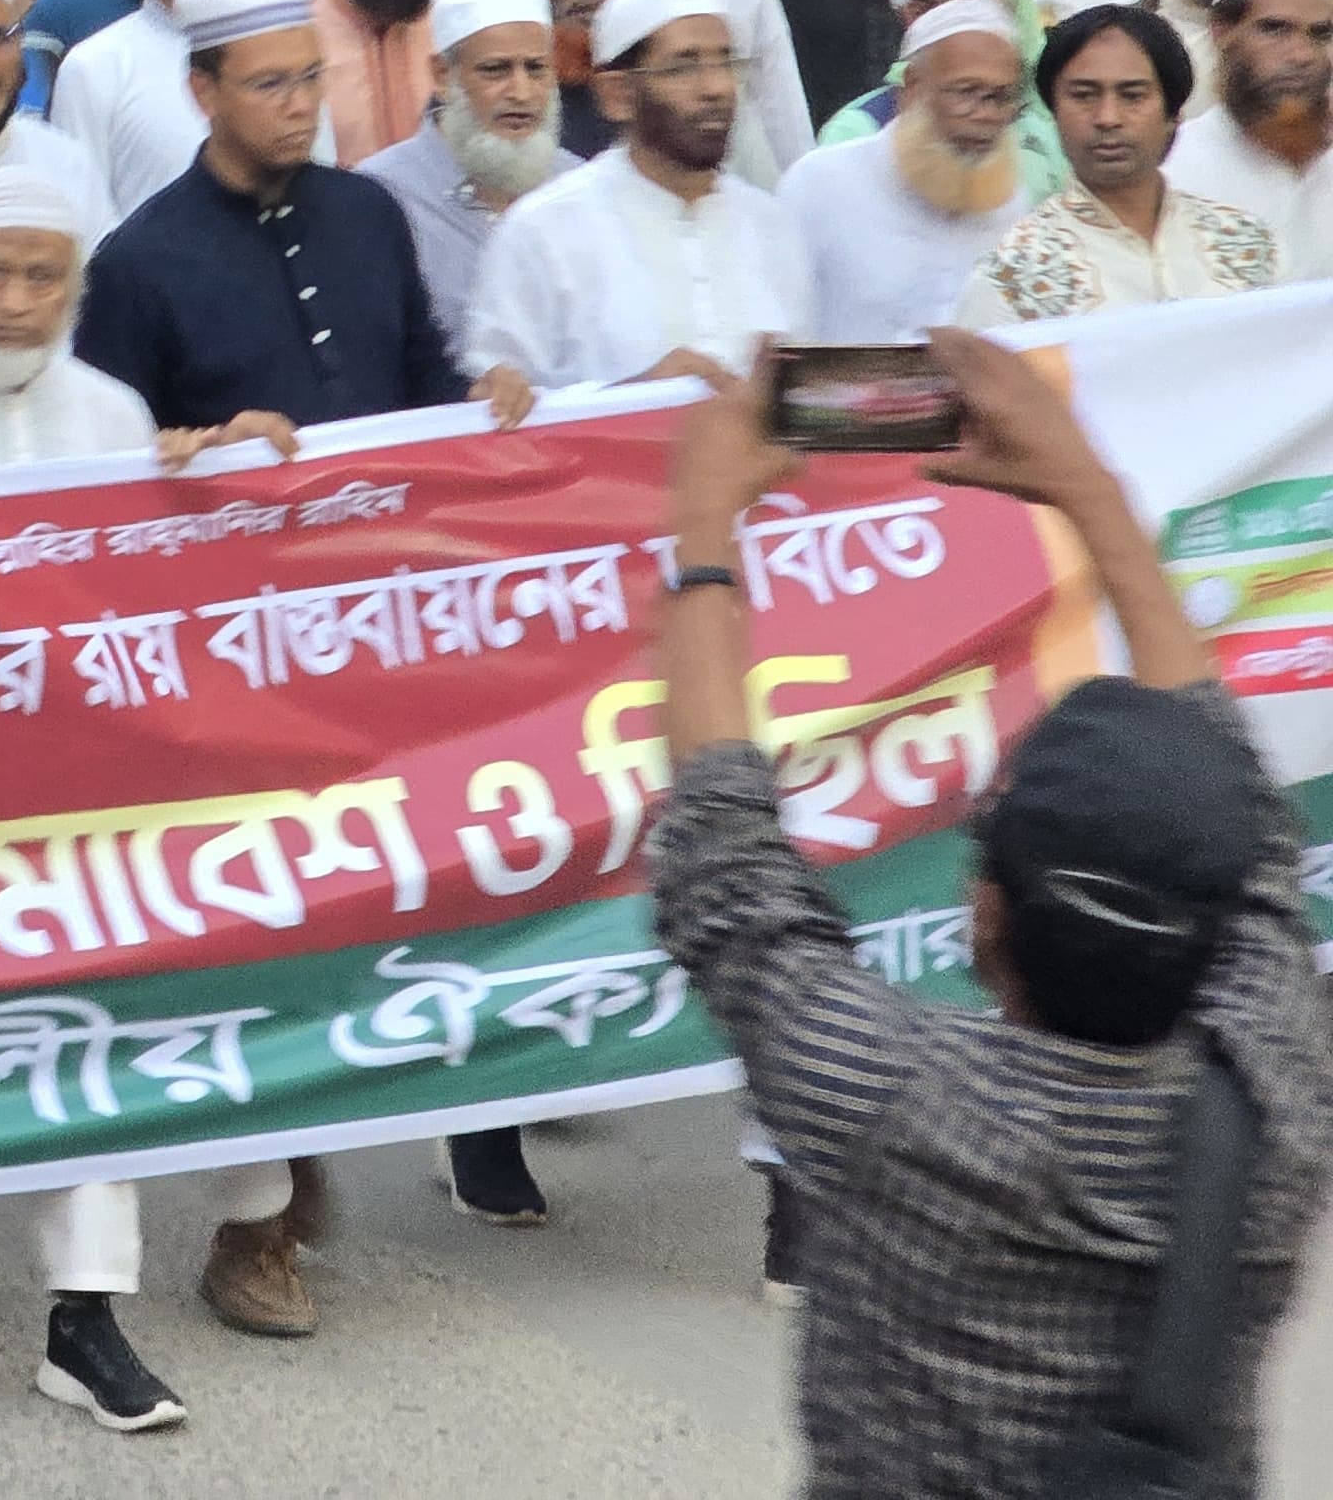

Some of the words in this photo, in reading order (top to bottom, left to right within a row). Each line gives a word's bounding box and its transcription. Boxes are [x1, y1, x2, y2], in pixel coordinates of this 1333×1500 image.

[59, 609, 190, 711] রায়
[191, 540, 631, 690] বাস্তবায়নের
[455, 760, 571, 897] ও
[328, 945, 691, 1069] ঐক্য
